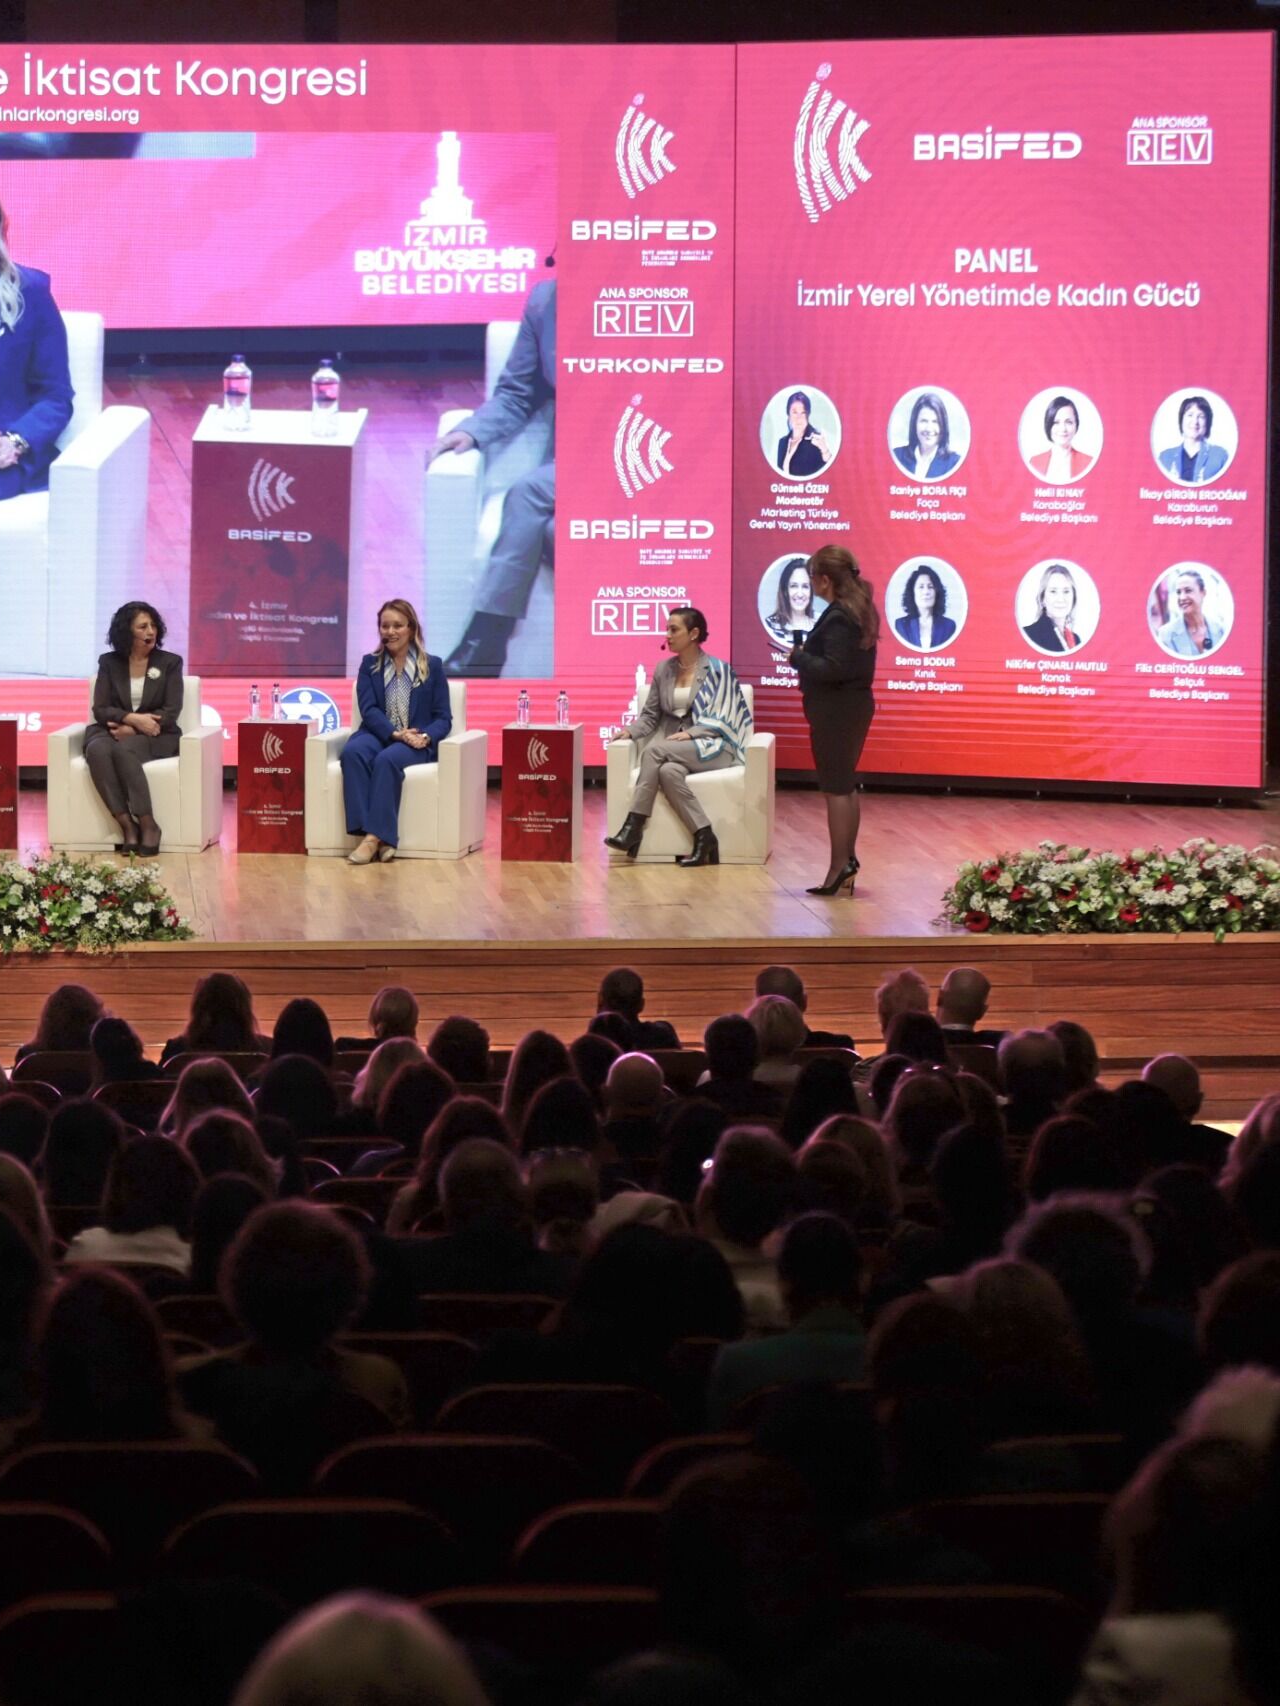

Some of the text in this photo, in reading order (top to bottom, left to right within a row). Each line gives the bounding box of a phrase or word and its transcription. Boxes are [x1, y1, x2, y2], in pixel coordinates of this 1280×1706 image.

[24, 52, 161, 96] İktisat
[175, 59, 367, 105] Kongresi
[1131, 115, 1208, 129] ANA SPONSOR
[913, 125, 1083, 161] BASİFED
[1132, 134, 1208, 161] REV
[571, 214, 717, 241] BASİFED
[354, 246, 537, 273] BÜYÜKŞEHİR
[954, 247, 1039, 273] PANEL
[361, 271, 527, 296] BELEDİYESİ
[599, 287, 689, 299] ANA SPONSOR
[797, 279, 1201, 308] İzmir Yerel Yönetimde Kadın Gücü
[601, 305, 689, 333] REV
[562, 357, 725, 374] TÜRKONFED
[760, 508, 839, 520] Marketing Türkiye
[1167, 503, 1218, 513] Karaburun
[889, 510, 928, 522] Belediye
[1020, 512, 1060, 524] Belediye
[1152, 514, 1193, 527] Belediye
[569, 513, 715, 540] BASİFED
[749, 519, 776, 529] Genel
[777, 520, 802, 532] Yayın
[228, 528, 312, 543] BASİFED
[596, 586, 687, 598] ANA SPONSOR
[895, 656, 956, 667] Sema BODUR
[914, 669, 937, 679] Kınık
[1041, 673, 1071, 683] Konak
[760, 676, 799, 688] Belediye
[887, 680, 926, 692] Belediye
[1173, 677, 1205, 688] Selçuk
[1017, 684, 1057, 696] Belediye
[1149, 688, 1190, 701] Belediye
